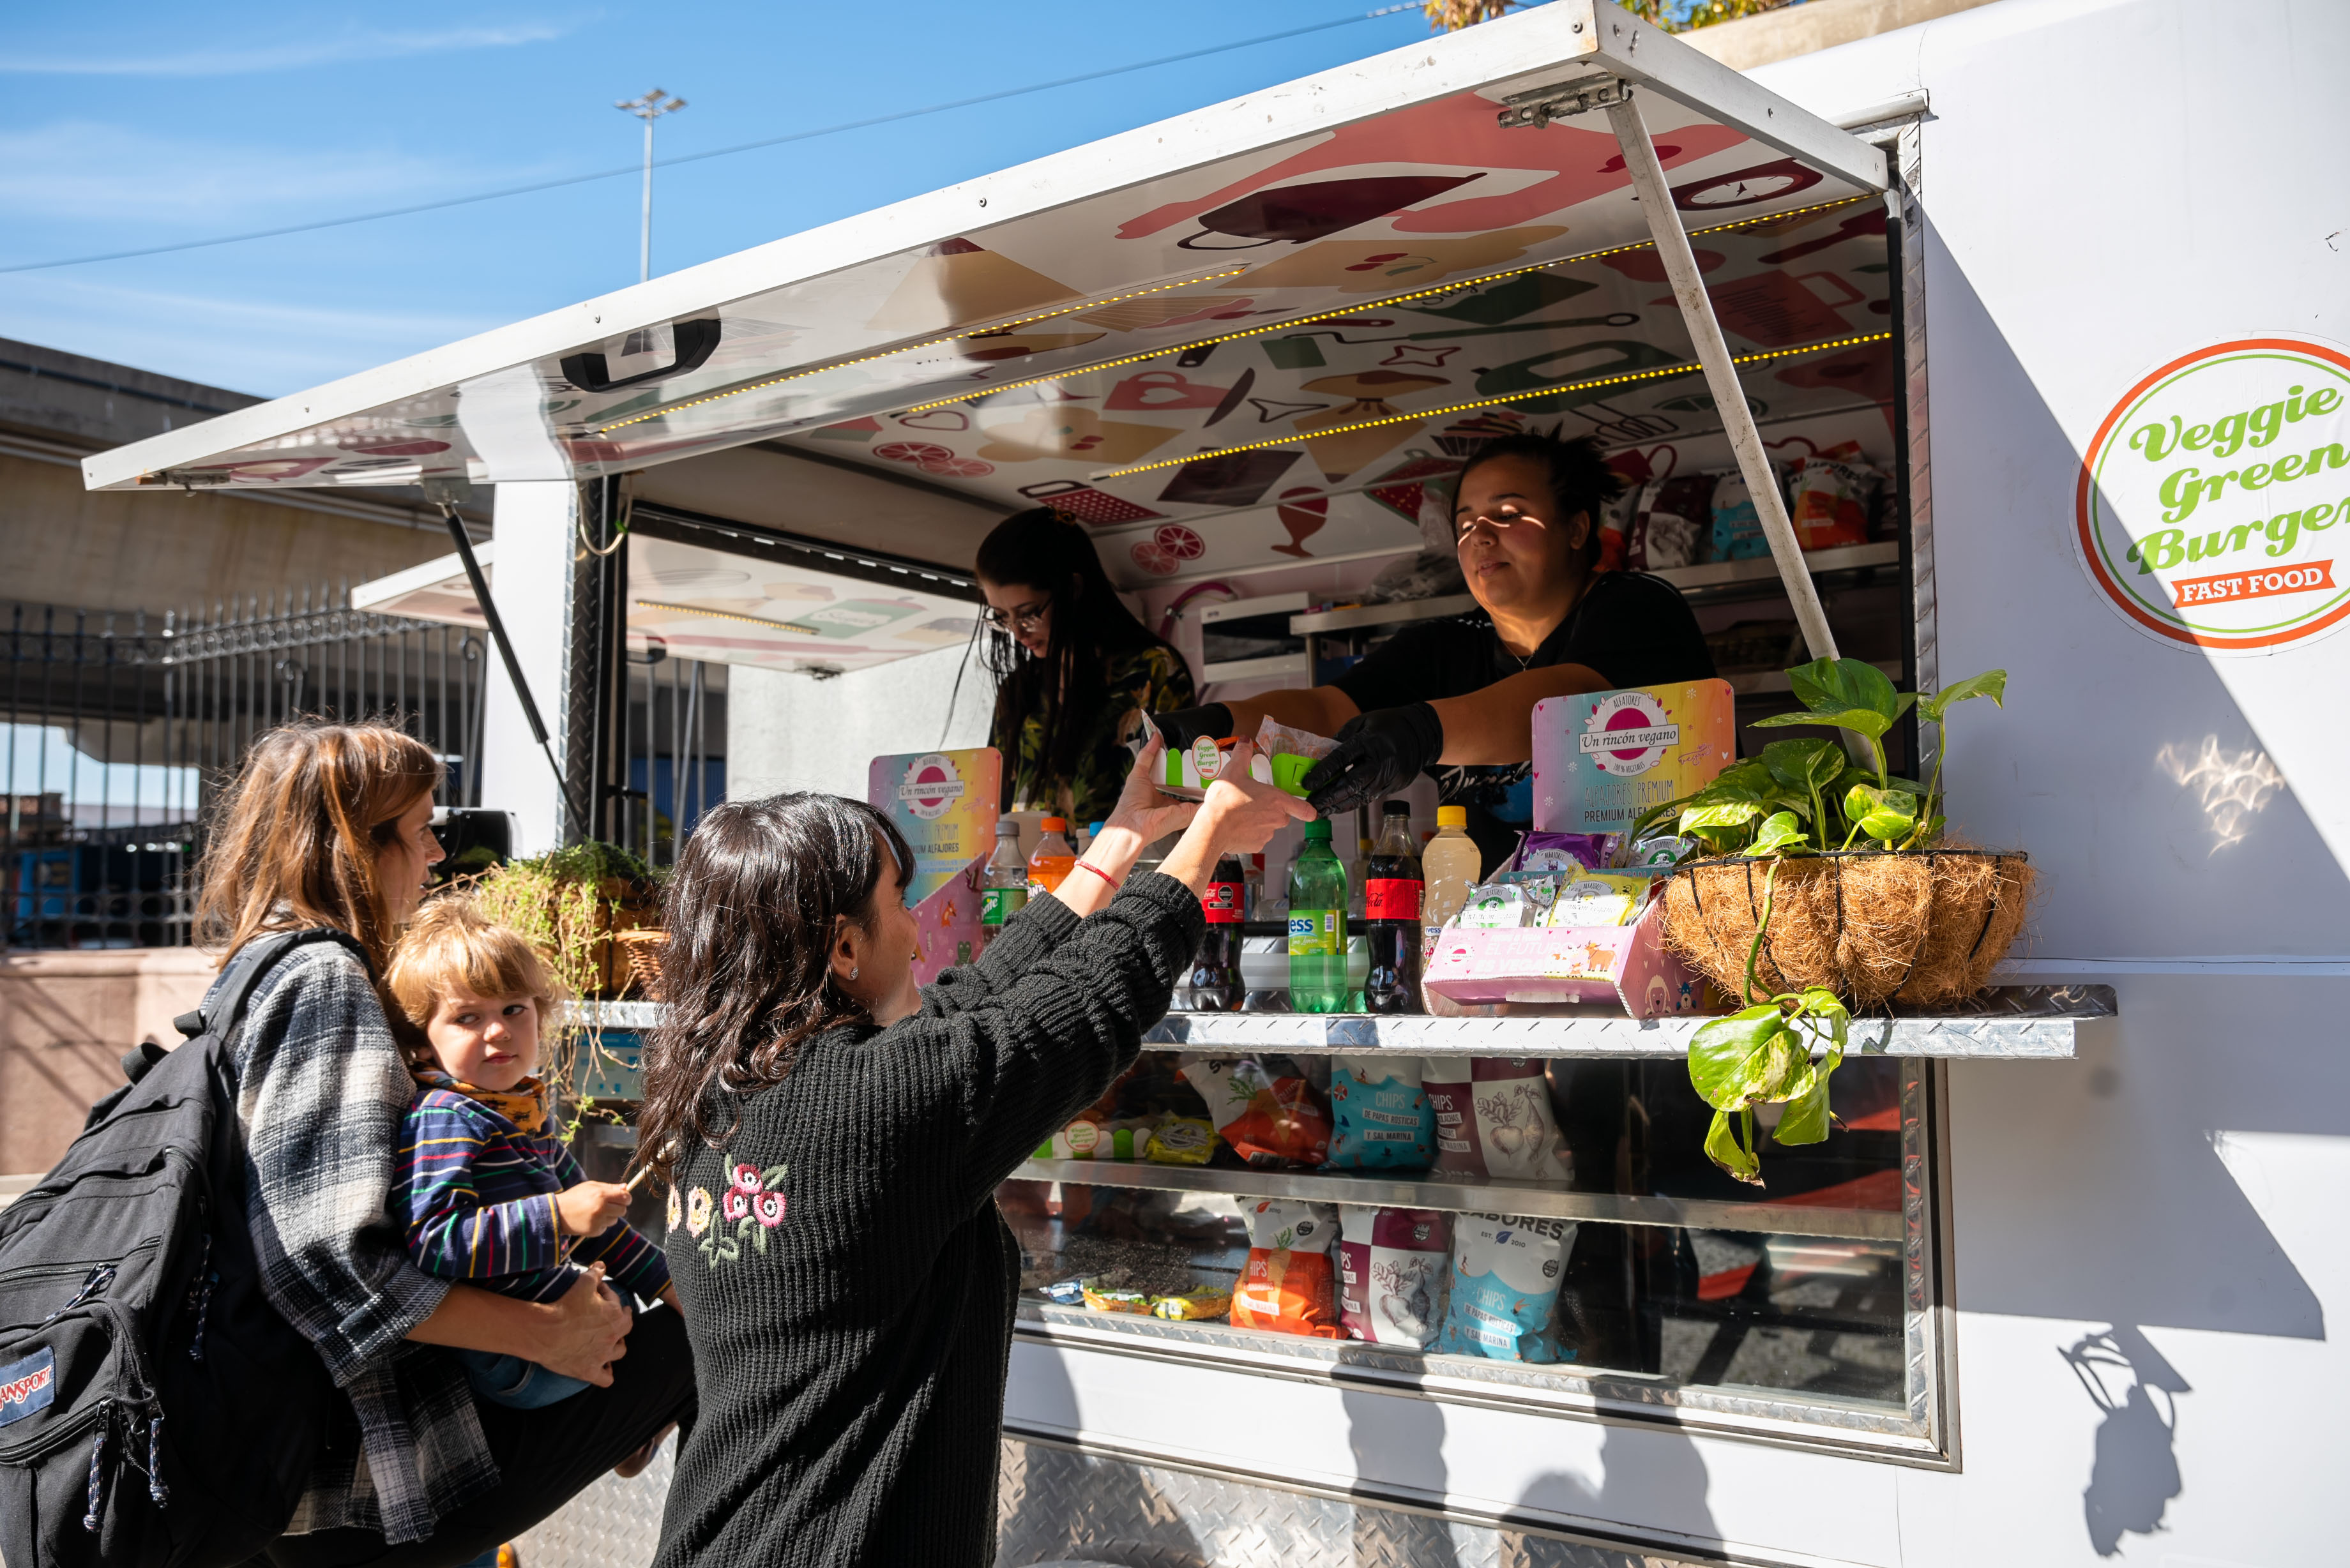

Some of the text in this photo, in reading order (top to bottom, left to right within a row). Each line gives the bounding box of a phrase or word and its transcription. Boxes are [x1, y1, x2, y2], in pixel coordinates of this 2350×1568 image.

[2128, 385, 2344, 462] Veggie
[2159, 443, 2350, 524] Green
[2182, 568, 2323, 602] FAST FOOD
[1613, 695, 1641, 709] ALFAJORES
[1582, 730, 1676, 748] Un rincón vegano
[901, 785, 963, 796] Un rincón vegano
[1584, 780, 1674, 808] ALFAJORES PREMIUM
[1584, 805, 1676, 822] PREMIUM ALFARES
[928, 842, 959, 854] ALFAJORES
[1582, 882, 1603, 891] ALFAJORES
[1289, 919, 1314, 932] ess
[1376, 1091, 1406, 1109] CHIPS
[1429, 1094, 1453, 1110] CHIPS
[1372, 1112, 1389, 1122] PAPAS
[1386, 1133, 1411, 1141] MARINA
[1446, 1142, 1468, 1151] MARINA
[1459, 1212, 1564, 1240] BORES
[1481, 1231, 1493, 1239] EST.
[1511, 1239, 1526, 1248] 2010
[1250, 1261, 1268, 1277] HIPS
[1476, 1286, 1506, 1311] CHIPS
[1465, 1304, 1471, 1314] DE
[1471, 1308, 1487, 1322] PAPAS
[1466, 1327, 1508, 1348] Y SAL MARINA
[0, 1365, 51, 1409] ANSPORT
